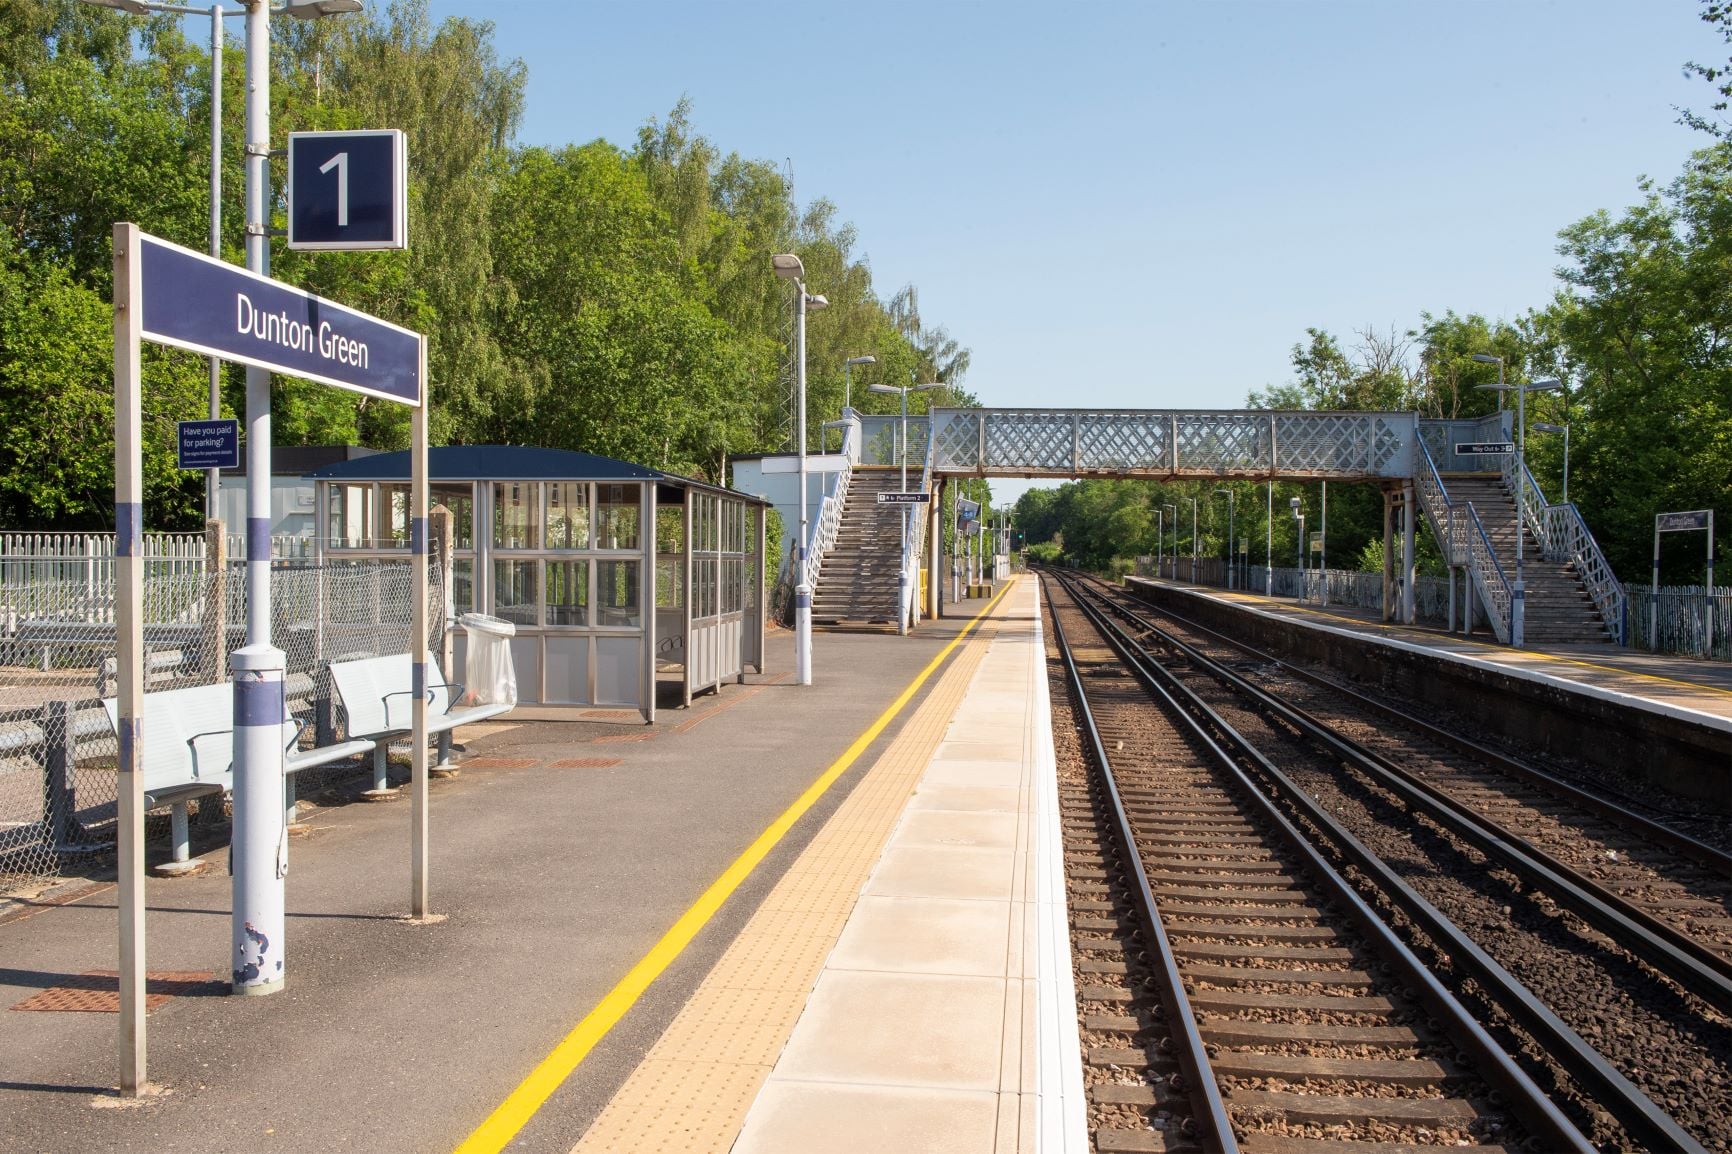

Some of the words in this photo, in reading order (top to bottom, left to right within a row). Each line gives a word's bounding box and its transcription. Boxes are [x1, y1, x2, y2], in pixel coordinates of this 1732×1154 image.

[319, 152, 348, 226] 1
[237, 293, 313, 353] Dunton
[318, 322, 368, 370] Green
[183, 427, 201, 436] Have
[202, 427, 216, 437] you
[216, 425, 232, 436] paid
[184, 438, 194, 448] for
[194, 437, 225, 449] parking?
